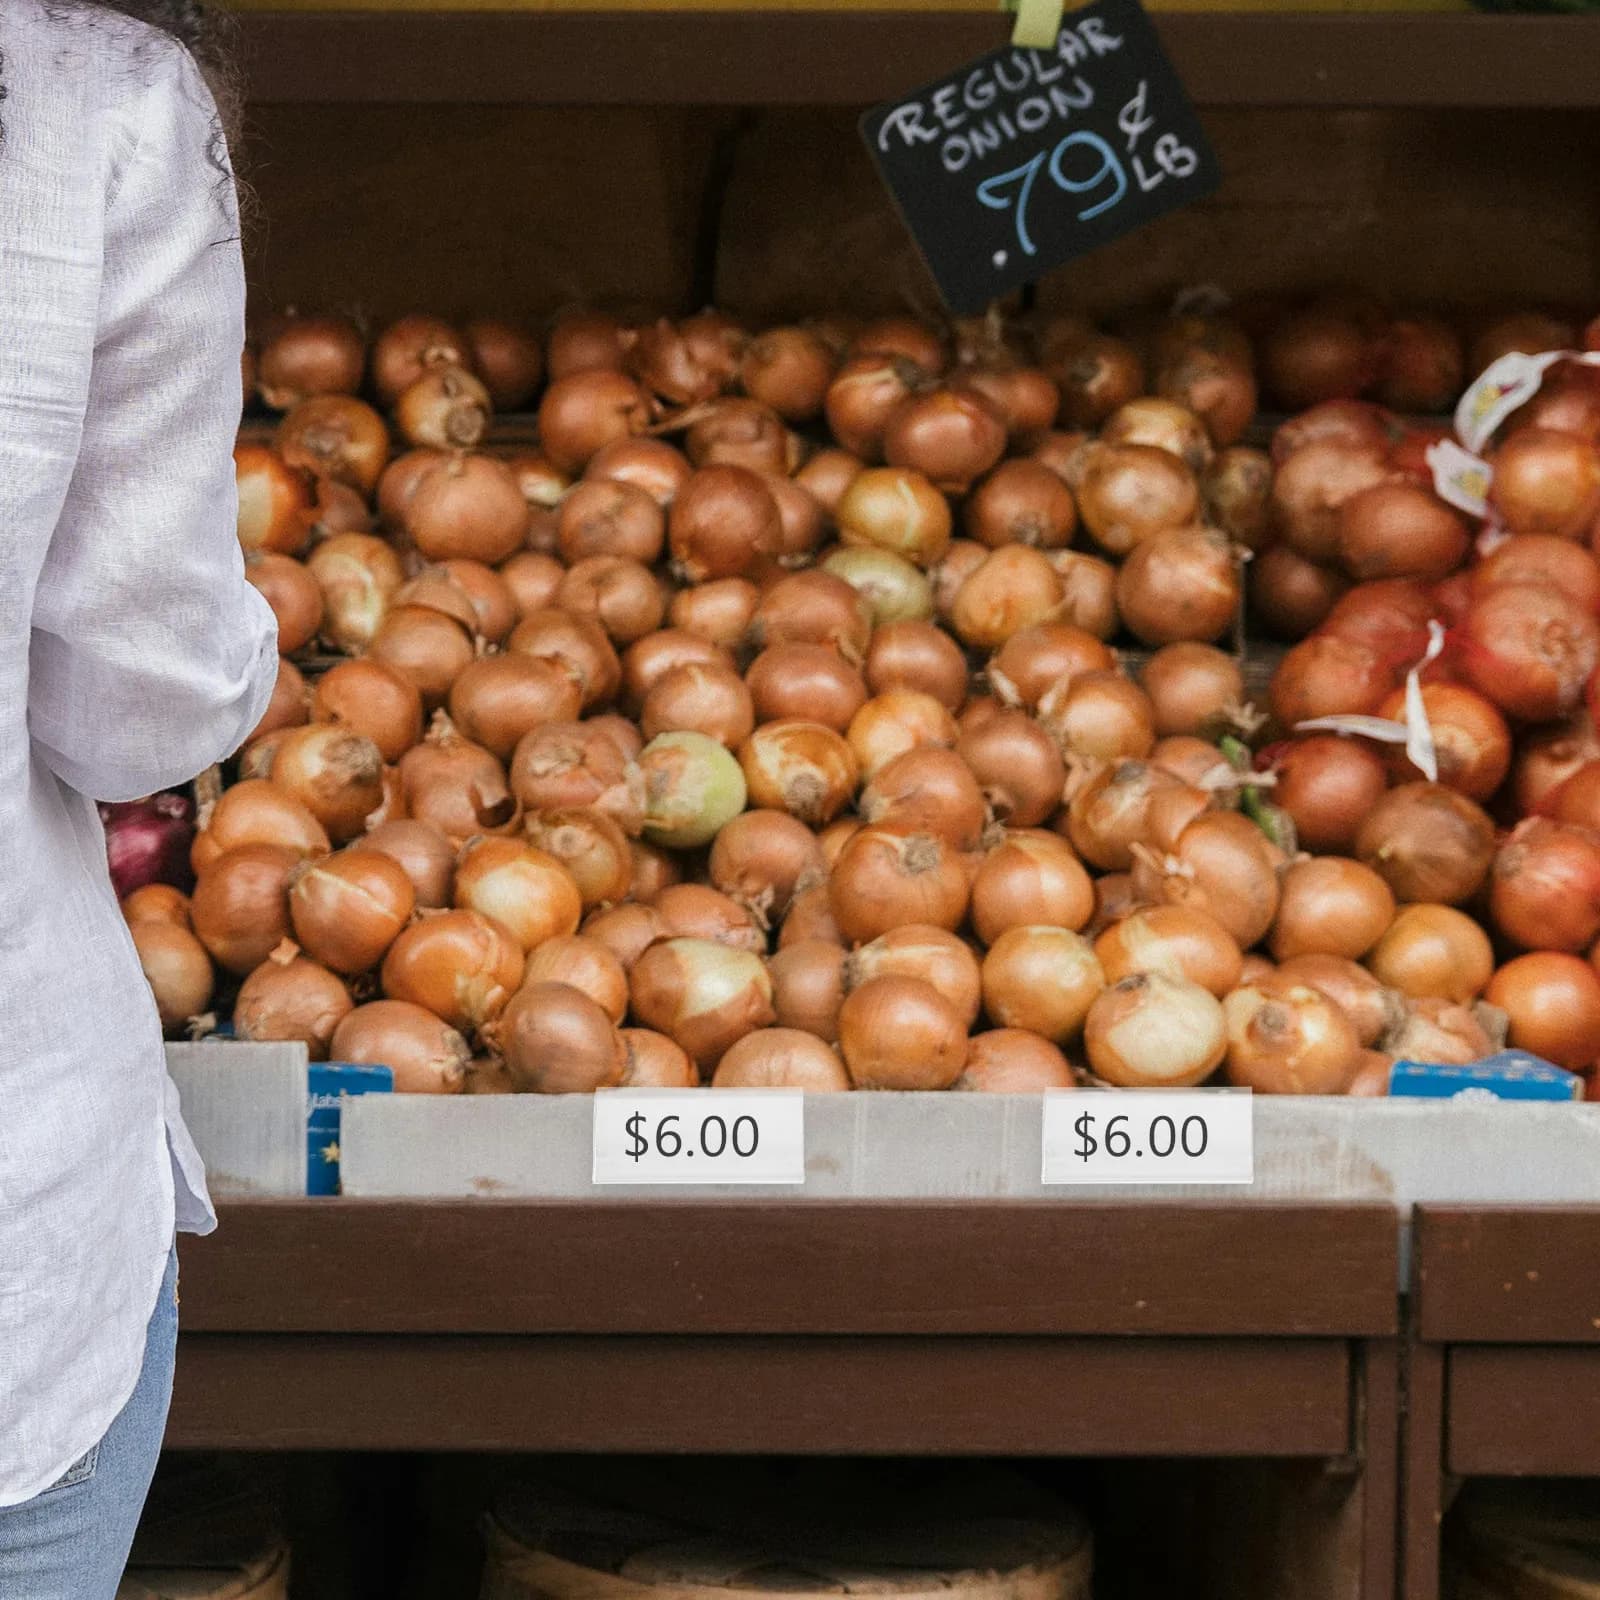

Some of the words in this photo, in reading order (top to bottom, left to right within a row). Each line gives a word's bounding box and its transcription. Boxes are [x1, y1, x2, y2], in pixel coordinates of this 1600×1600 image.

[878, 17, 1124, 151] REGULAR
[941, 76, 1093, 172] ONION
[1132, 133, 1197, 191] LB
[625, 1110, 760, 1163] $6.00
[1073, 1110, 1208, 1163] $6.00
